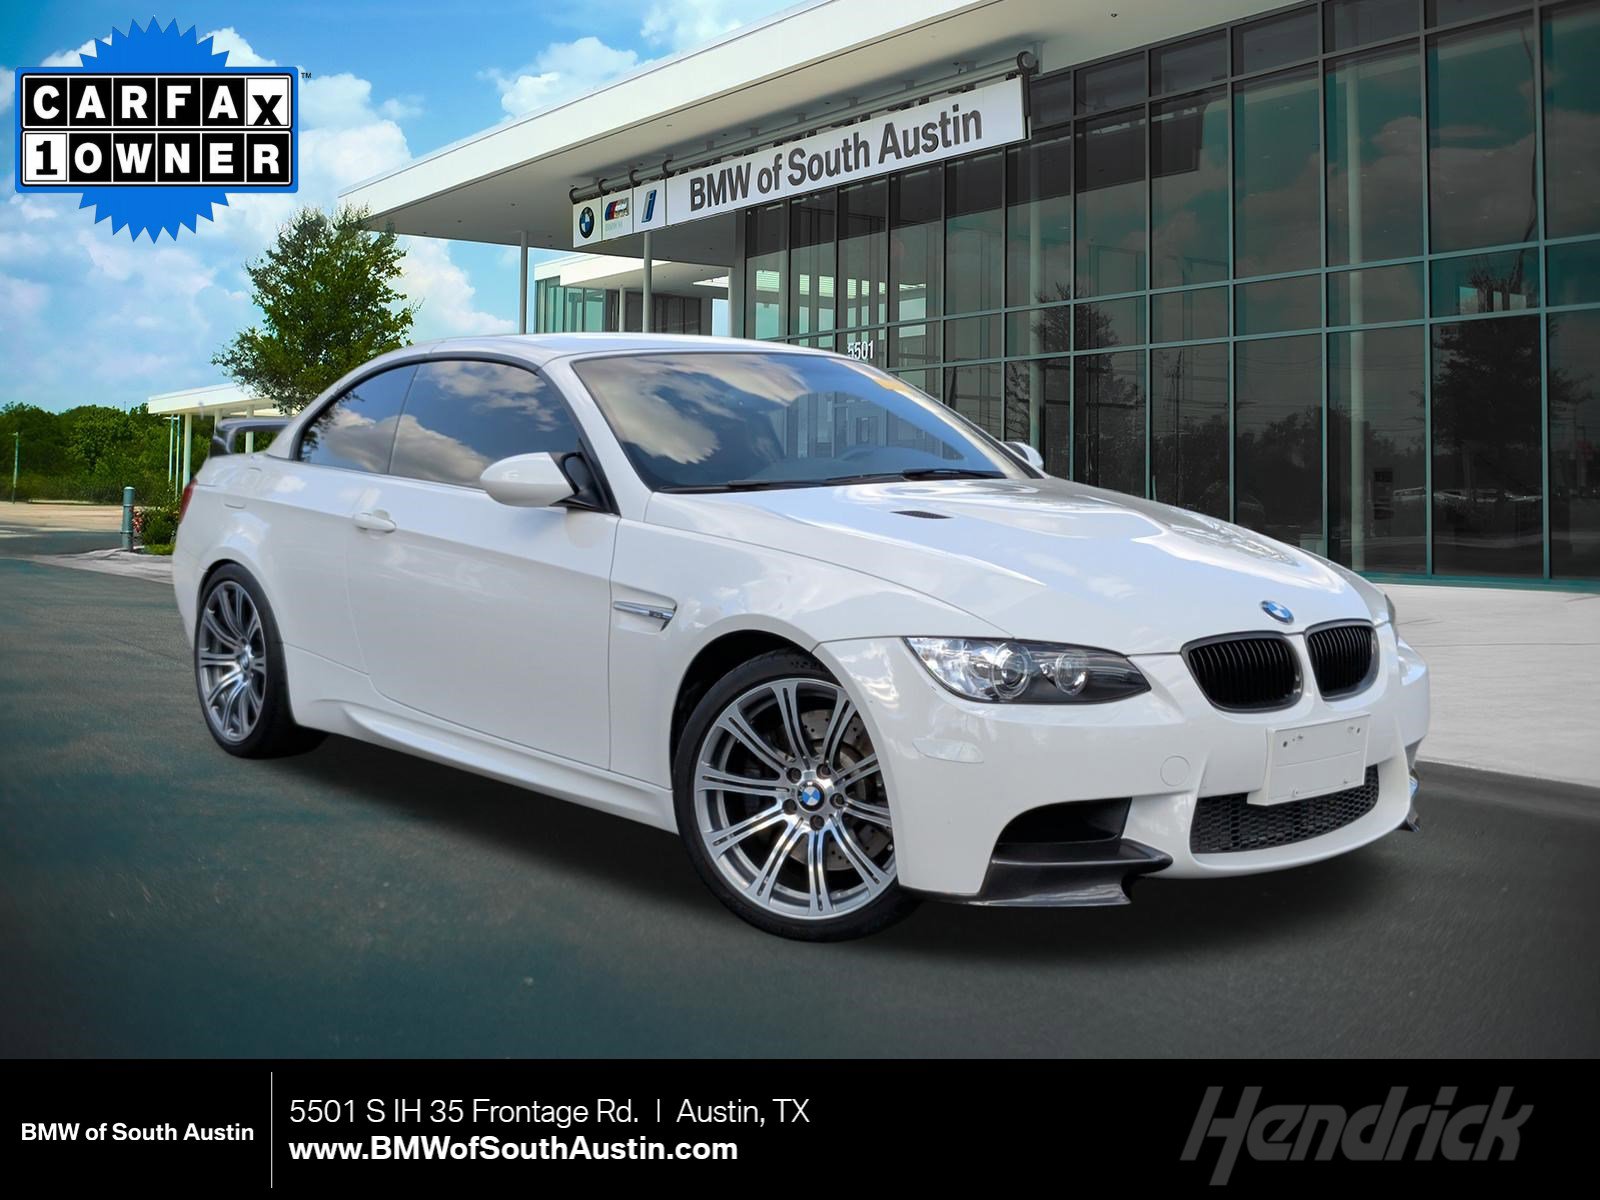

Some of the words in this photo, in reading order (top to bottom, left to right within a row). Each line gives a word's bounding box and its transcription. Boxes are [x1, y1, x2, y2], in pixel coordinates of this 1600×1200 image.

[690, 162, 751, 211] BMW
[757, 153, 783, 194] of
[787, 132, 870, 186] South
[878, 103, 982, 164] Austin
[847, 340, 874, 360] 5501
